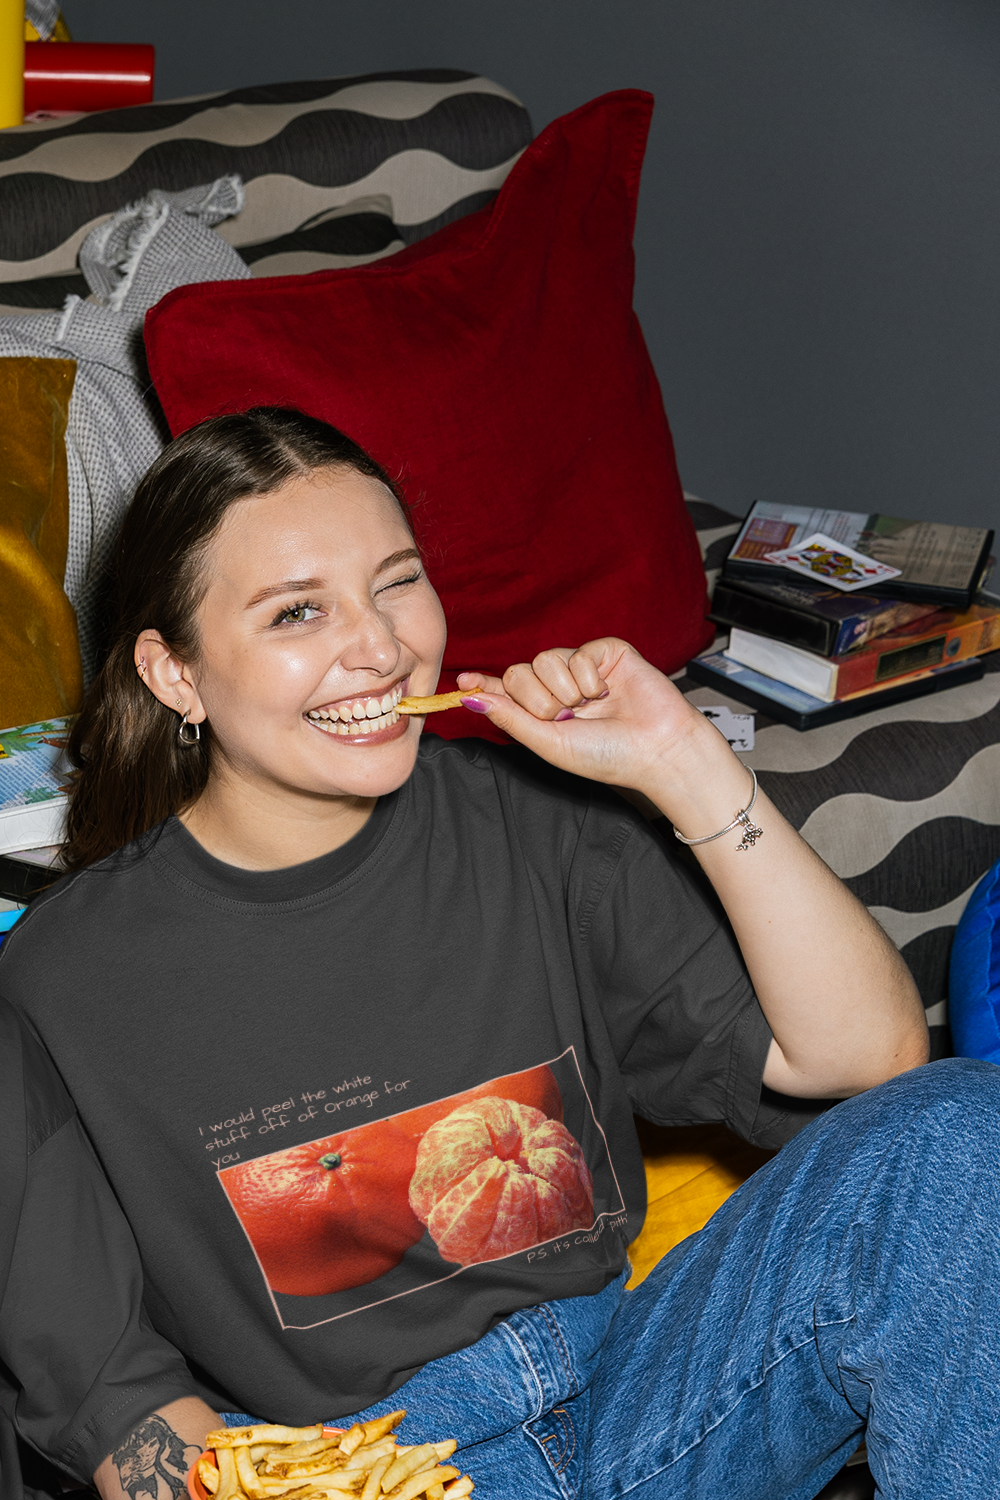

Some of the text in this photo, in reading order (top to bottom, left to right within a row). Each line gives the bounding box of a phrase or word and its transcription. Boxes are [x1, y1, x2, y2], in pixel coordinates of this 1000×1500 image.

[198, 1075, 372, 1136] I would peel the white
[205, 1079, 411, 1152] stuff off of Orange for
[211, 1151, 241, 1172] you
[552, 1240, 570, 1254] it's
